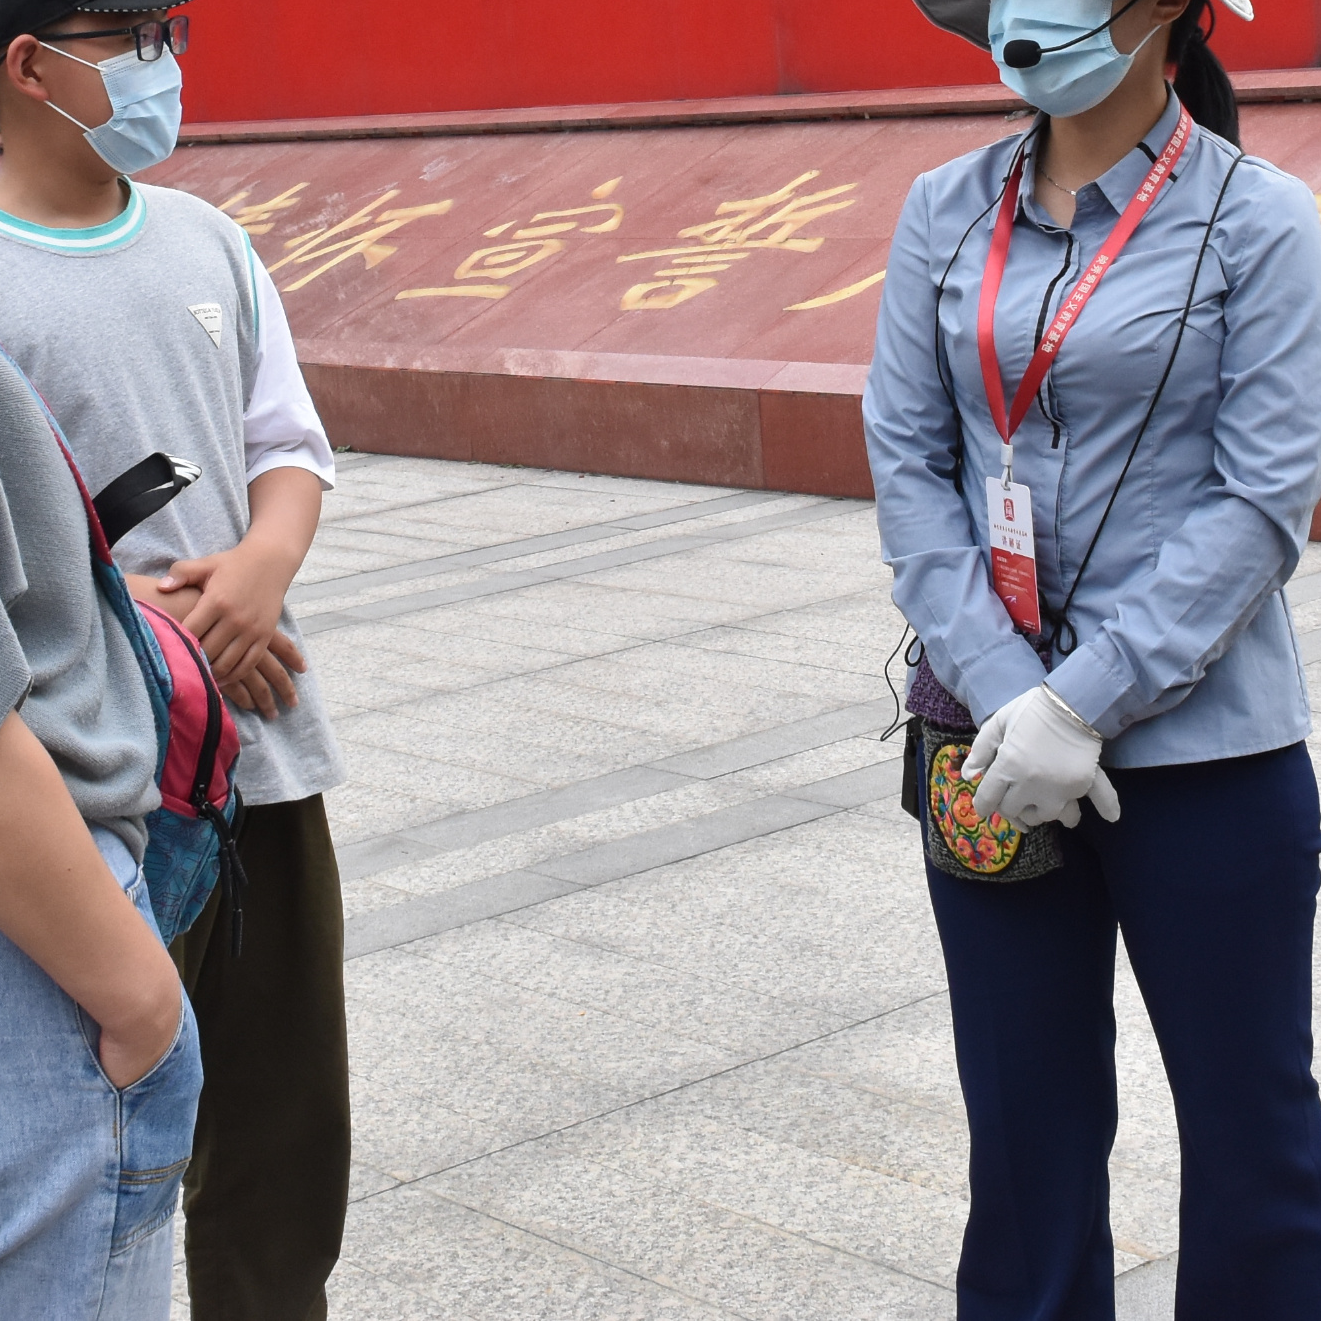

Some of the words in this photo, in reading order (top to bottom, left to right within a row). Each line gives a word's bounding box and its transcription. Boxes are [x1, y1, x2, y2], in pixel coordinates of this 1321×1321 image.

[1041, 254, 1109, 354] 映秀爱国主义教育基地
